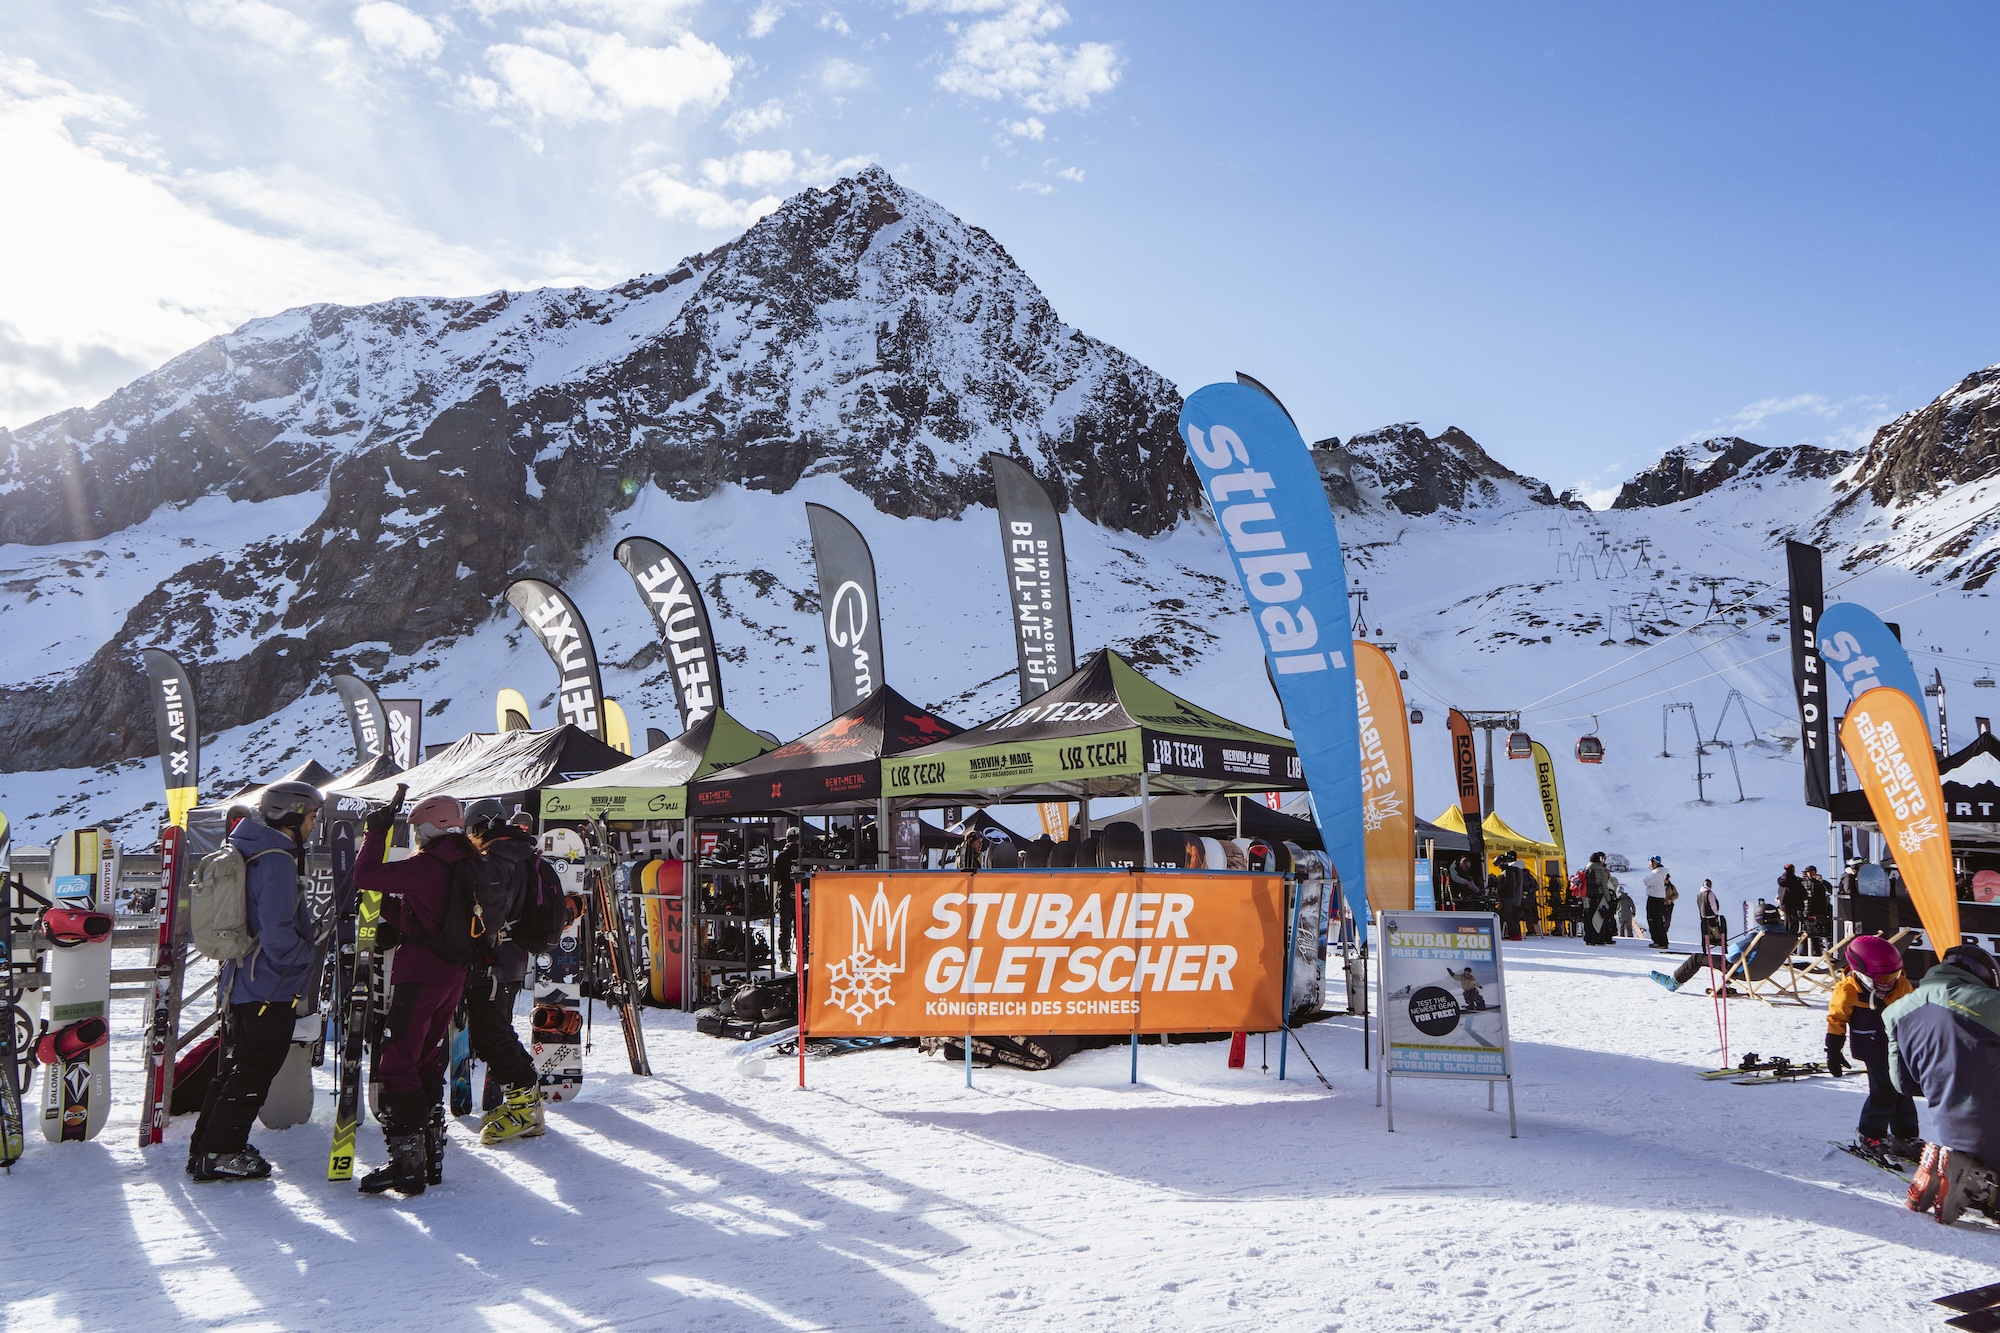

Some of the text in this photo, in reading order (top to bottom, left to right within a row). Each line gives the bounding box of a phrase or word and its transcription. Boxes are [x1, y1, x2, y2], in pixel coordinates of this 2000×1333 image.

[1187, 422, 1347, 675] stubai
[985, 702, 1119, 732] LIB TECH
[619, 748, 690, 772] Gnu
[970, 752, 1033, 771] MERVIN MADE
[1060, 740, 1127, 771] LIB TECH
[1152, 738, 1205, 769] LIB TECH
[1222, 749, 1271, 766] MERVIN MADE
[891, 762, 946, 787] LIB TECH
[992, 769, 1018, 778] HAZARDOUS
[1018, 768, 1033, 776] WASTE
[1459, 735, 1475, 797] ROME
[546, 796, 571, 812] Gnu
[648, 794, 679, 812] Gnu
[1539, 762, 1556, 833] Bataleon
[104, 861, 112, 903] SALOMON
[160, 839, 173, 924] LUSTI
[923, 892, 1195, 940] STUBAIER
[359, 926, 377, 938] SC
[1390, 932, 1490, 949] STUBAI ZOO
[1391, 948, 1491, 960] PARK & TEST DAYS
[924, 945, 1238, 993] GLETSCHER
[925, 998, 1140, 1016] KÖNIGREICH DES SCHNEES
[1410, 1001, 1457, 1014] NEWEST GEAR
[1416, 999, 1432, 1007] TEST
[1414, 1008, 1457, 1023] FOR FREE!
[1391, 1050, 1502, 1064] 08.-10. NOVEMBER 2024
[1391, 1059, 1503, 1074] STUBAIER GLETSCHER
[51, 1061, 61, 1105] SALOMON
[154, 1098, 164, 1128] SL
[332, 1156, 352, 1171] 13
